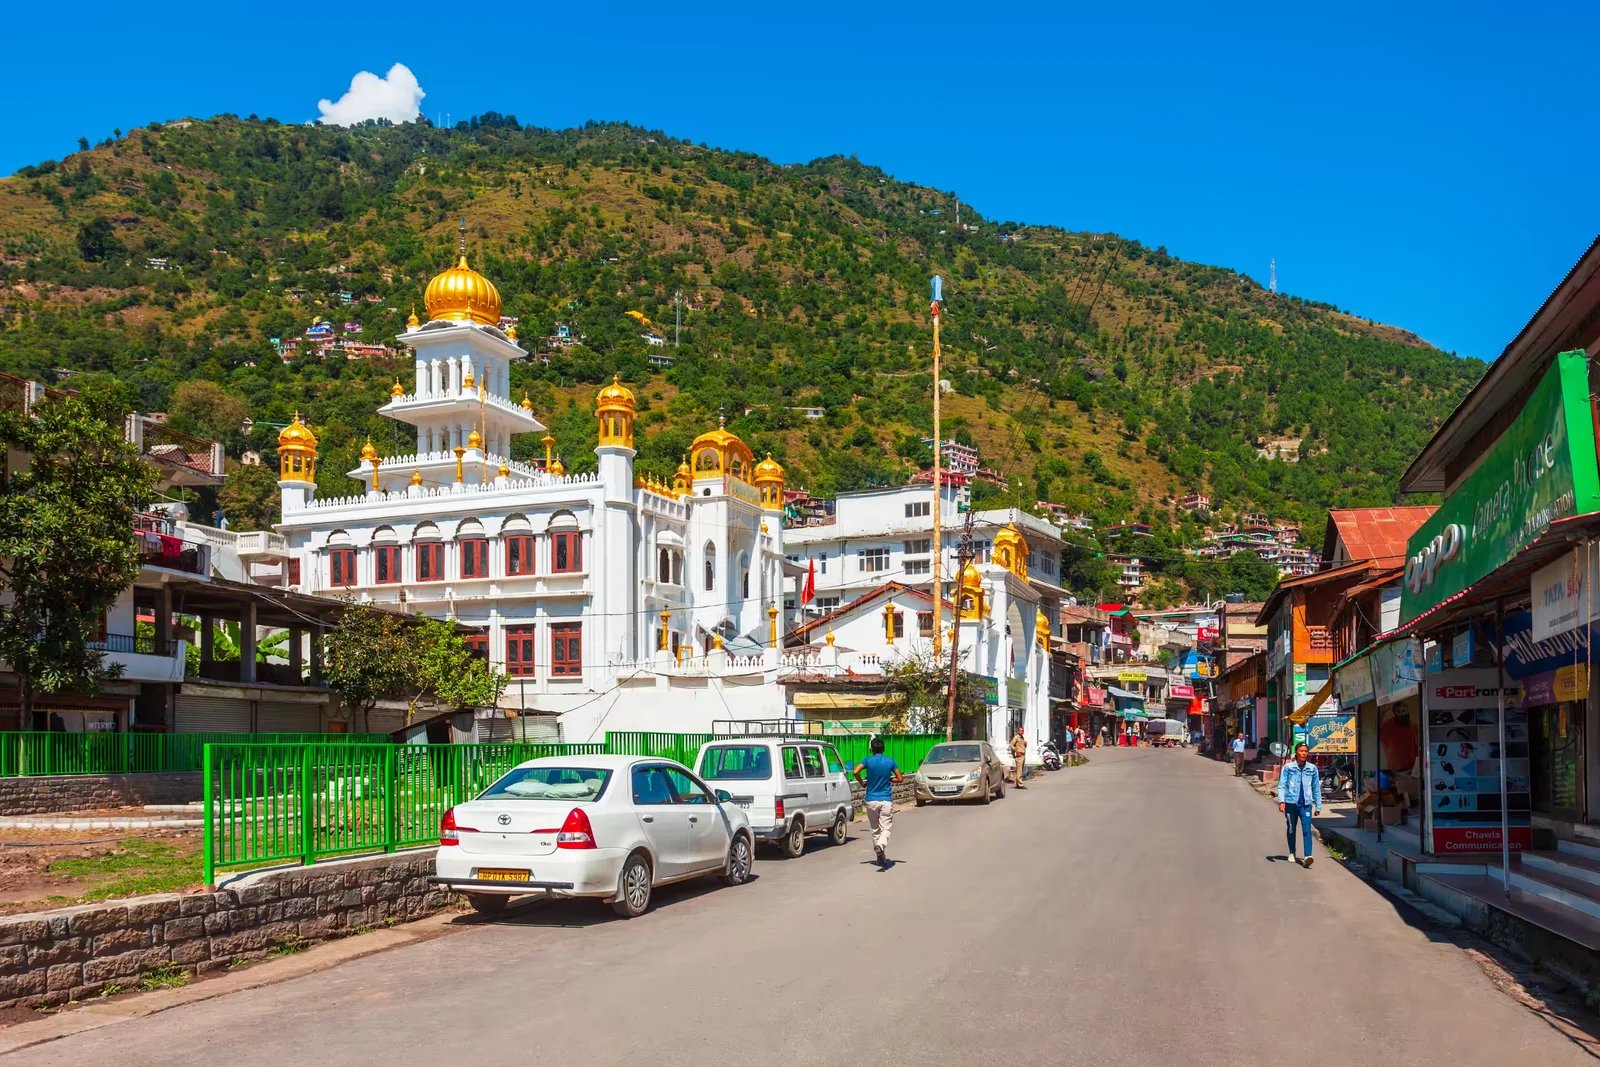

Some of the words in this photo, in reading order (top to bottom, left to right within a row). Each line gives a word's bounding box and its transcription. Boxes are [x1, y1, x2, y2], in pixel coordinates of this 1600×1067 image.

[1544, 582, 1564, 607] TATA
[1445, 686, 1519, 697] Portroncs
[1465, 831, 1501, 839] Chawla
[1445, 841, 1521, 849] Communicaon
